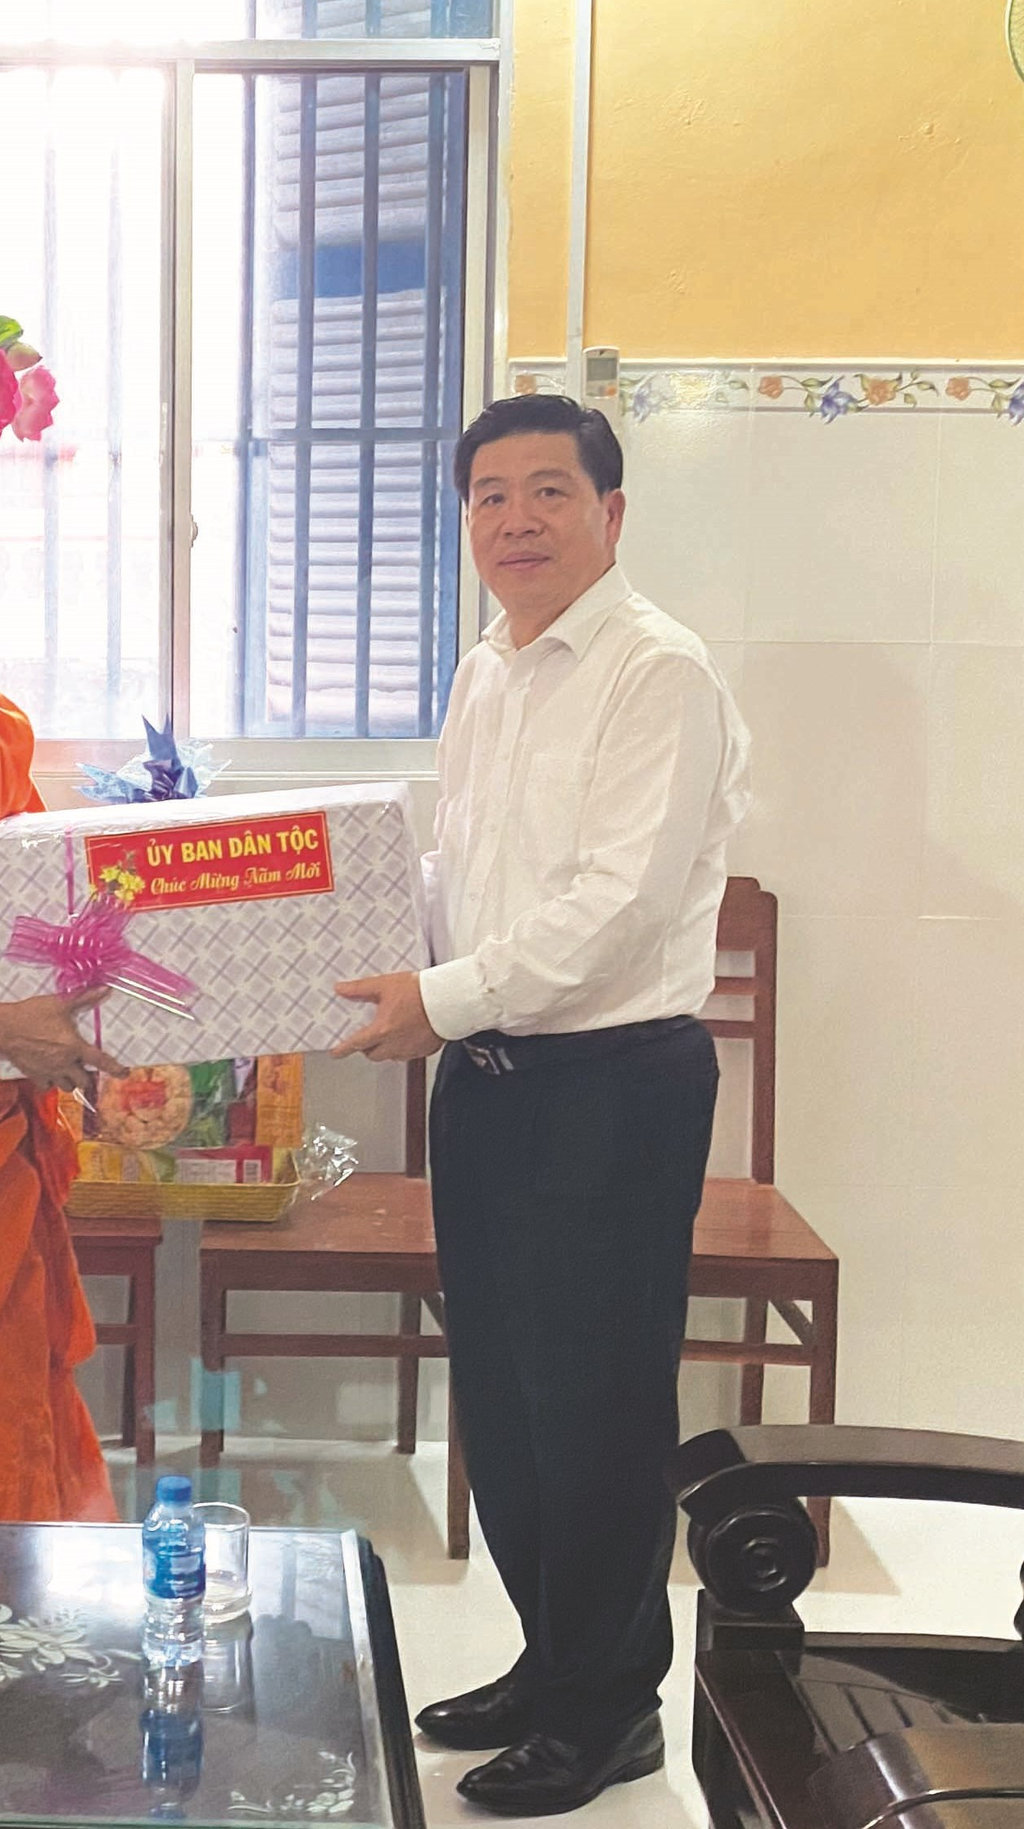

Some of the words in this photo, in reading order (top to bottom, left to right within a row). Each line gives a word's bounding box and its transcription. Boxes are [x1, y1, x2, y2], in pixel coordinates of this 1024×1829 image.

[146, 838, 174, 867] ỦY
[181, 839, 223, 864] BAN
[228, 830, 272, 858] DÂN
[276, 825, 319, 855] TỘC
[150, 877, 187, 896] Chúc
[190, 872, 240, 892] Mừng
[285, 861, 322, 881] Mới
